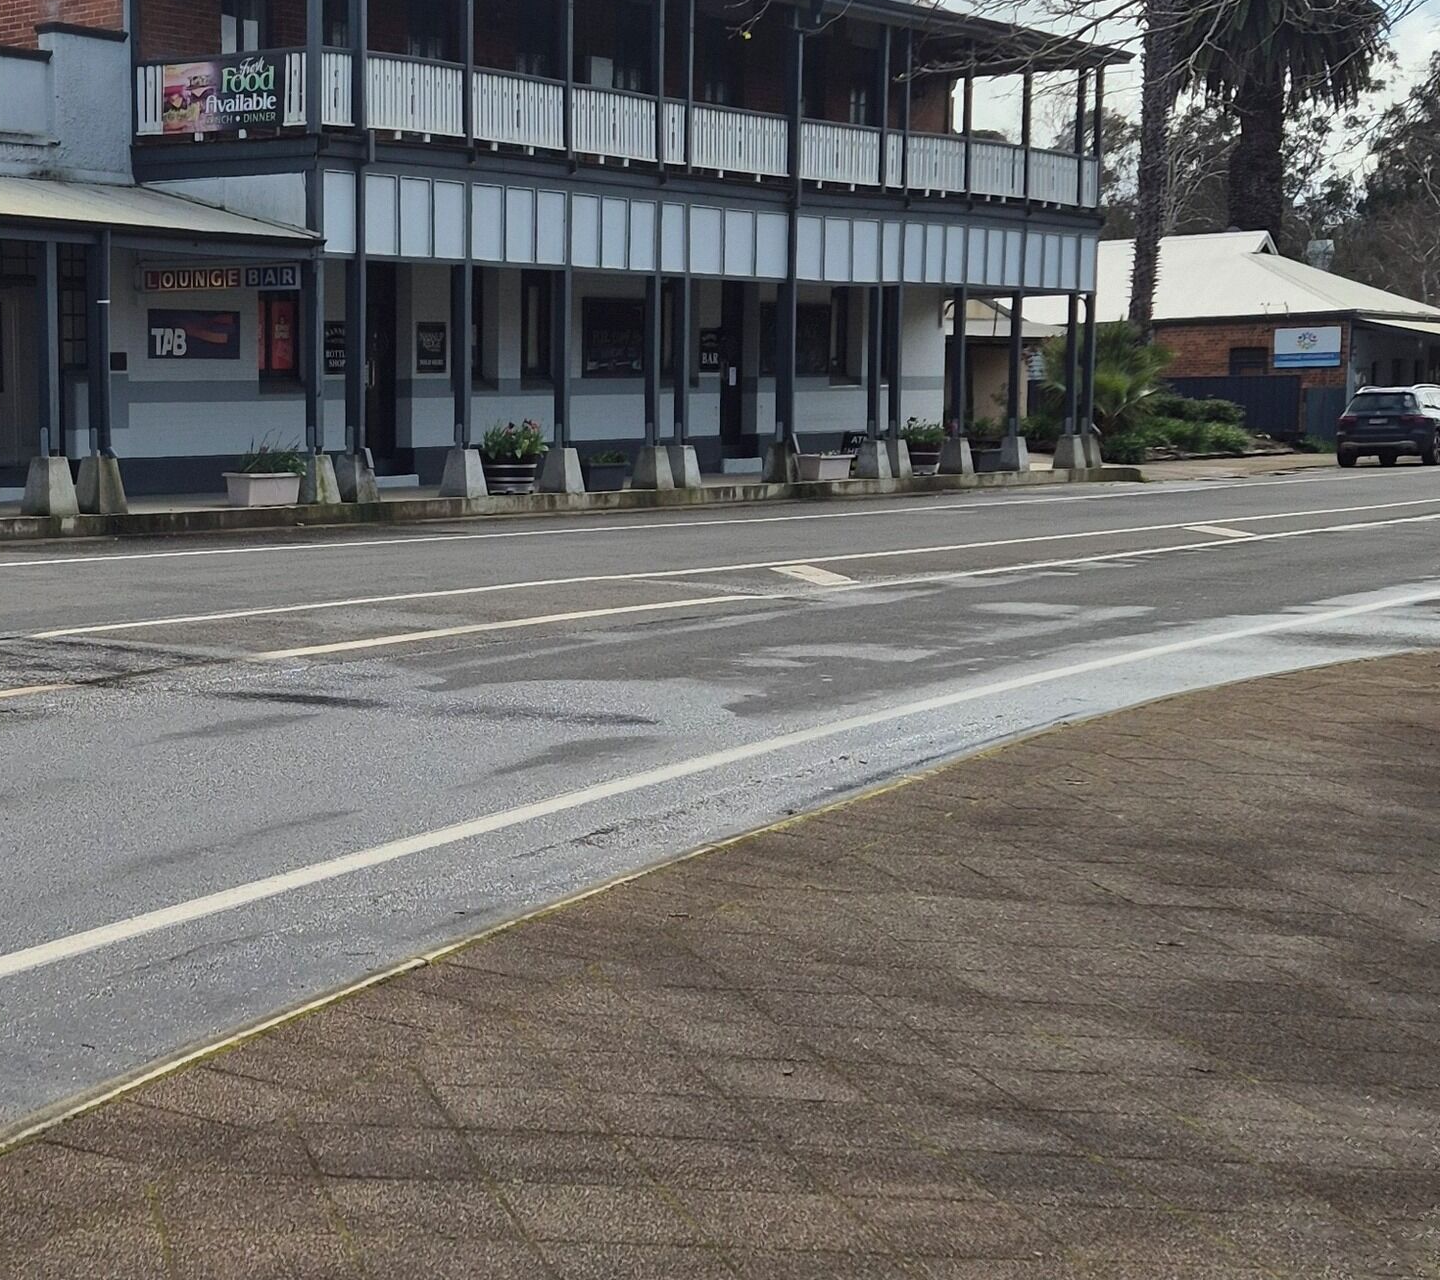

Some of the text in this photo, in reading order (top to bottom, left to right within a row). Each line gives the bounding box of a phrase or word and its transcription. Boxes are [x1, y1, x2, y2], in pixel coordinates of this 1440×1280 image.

[221, 65, 275, 94] Food
[205, 92, 277, 114] Available
[243, 112, 276, 123] DINNER
[147, 268, 294, 289] LOUNGE BAR
[151, 328, 187, 356] TAB
[702, 352, 718, 364] BAR
